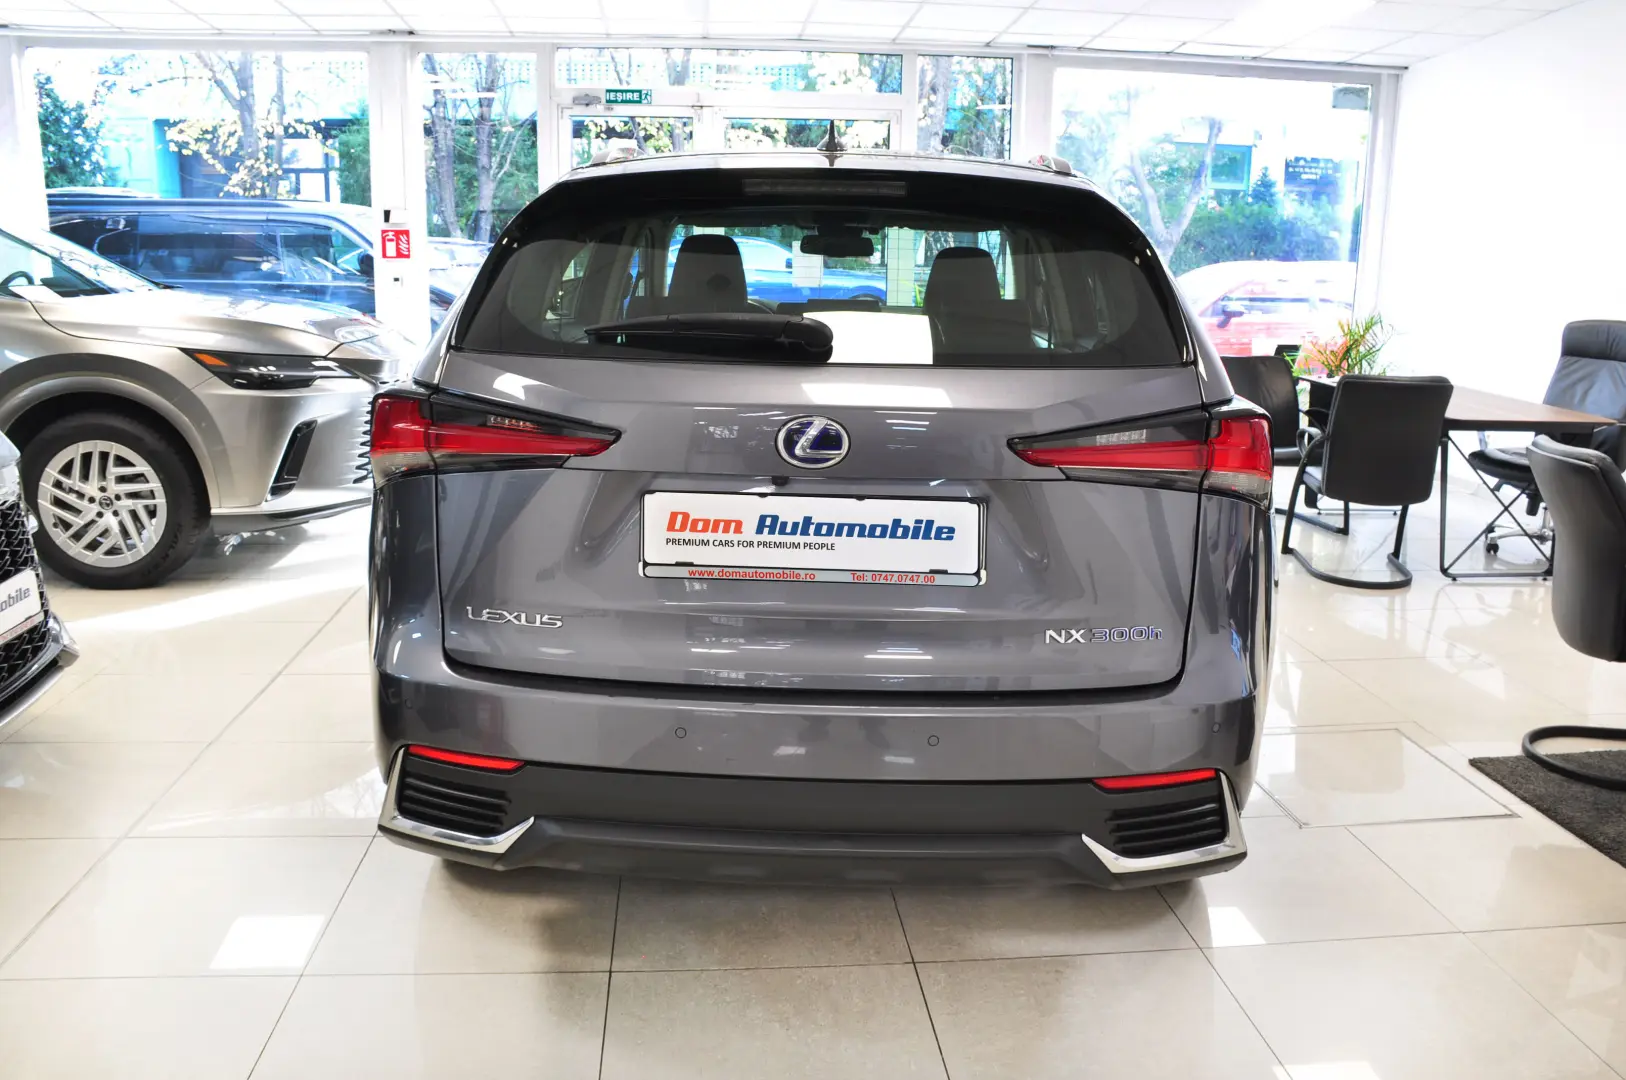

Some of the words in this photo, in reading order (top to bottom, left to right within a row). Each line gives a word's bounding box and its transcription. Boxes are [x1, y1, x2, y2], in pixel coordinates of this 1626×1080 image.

[666, 511, 743, 535] Dom
[755, 514, 956, 541] Automobile
[665, 537, 710, 547] PREMIUM
[712, 539, 735, 548] CARS
[737, 540, 755, 548] FOR
[757, 541, 801, 550] PREMIUM
[803, 542, 835, 551] PEOPLE
[688, 568, 816, 581] www.domautomobile.ro
[851, 572, 868, 582] Tel:
[871, 573, 936, 584] 0747.0747.00
[466, 606, 563, 629] LEXUS
[1045, 628, 1087, 644] NX
[1091, 625, 1163, 643] 300h
